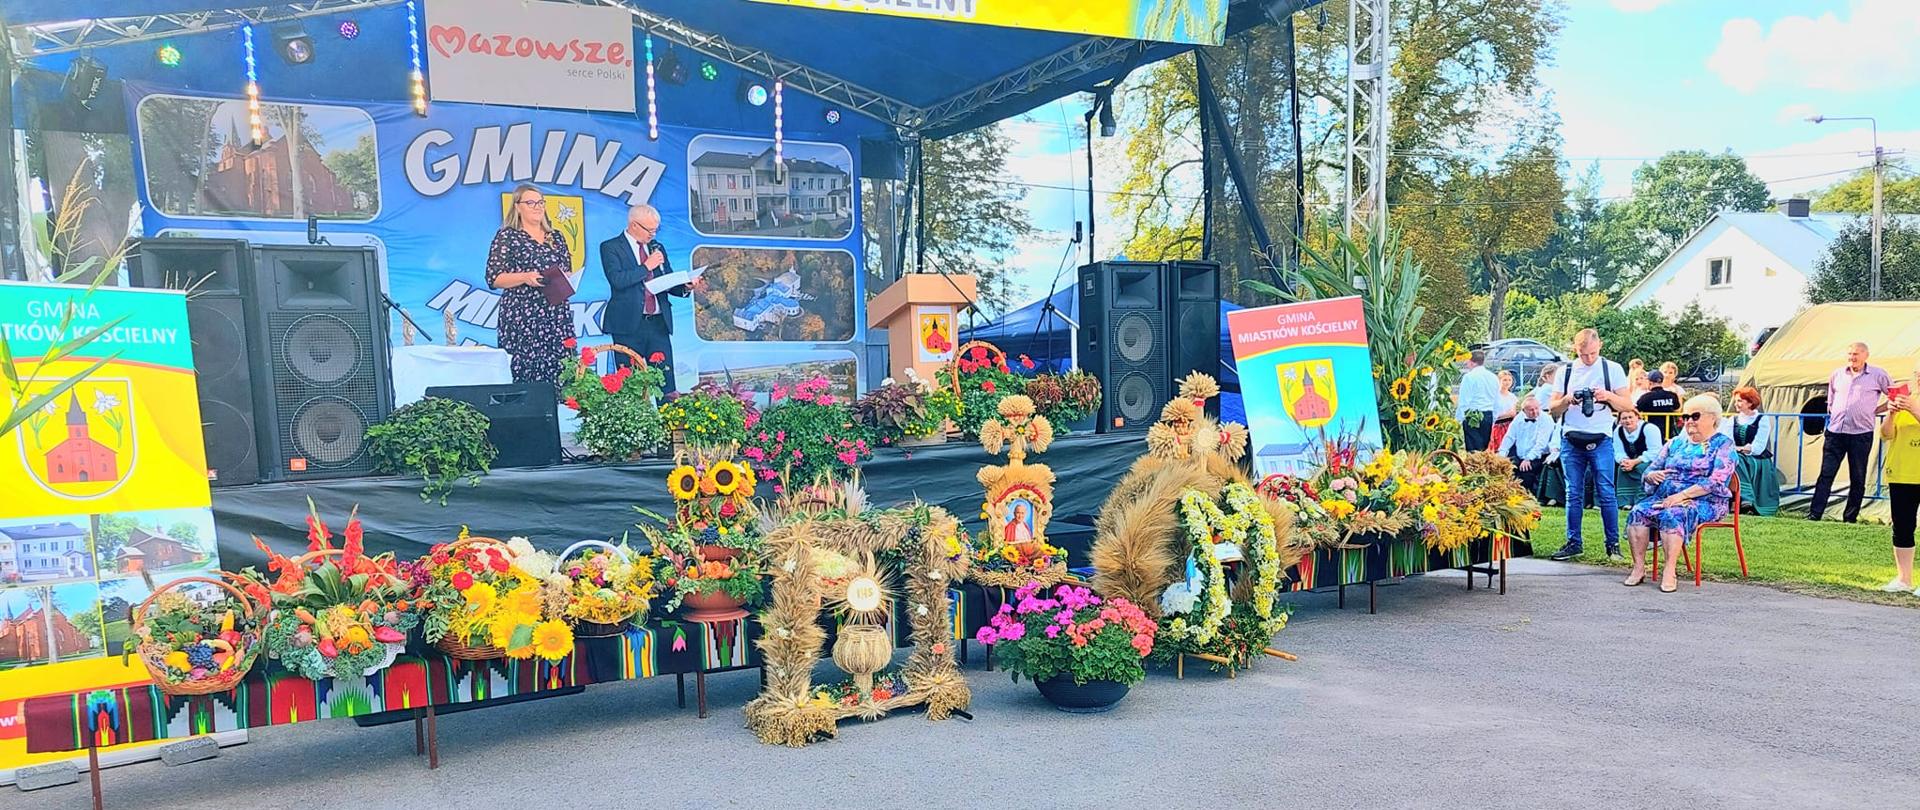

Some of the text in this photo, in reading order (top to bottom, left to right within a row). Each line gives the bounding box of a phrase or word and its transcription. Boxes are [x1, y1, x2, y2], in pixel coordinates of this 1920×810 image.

[567, 68, 625, 80] serce Polski
[405, 123, 666, 206] GMINA
[27, 300, 100, 320] GMNA
[1277, 311, 1316, 325] GMINA
[0, 320, 65, 342] TKÓW
[1238, 319, 1358, 343] MIASTKÓW KOŚCIELNY
